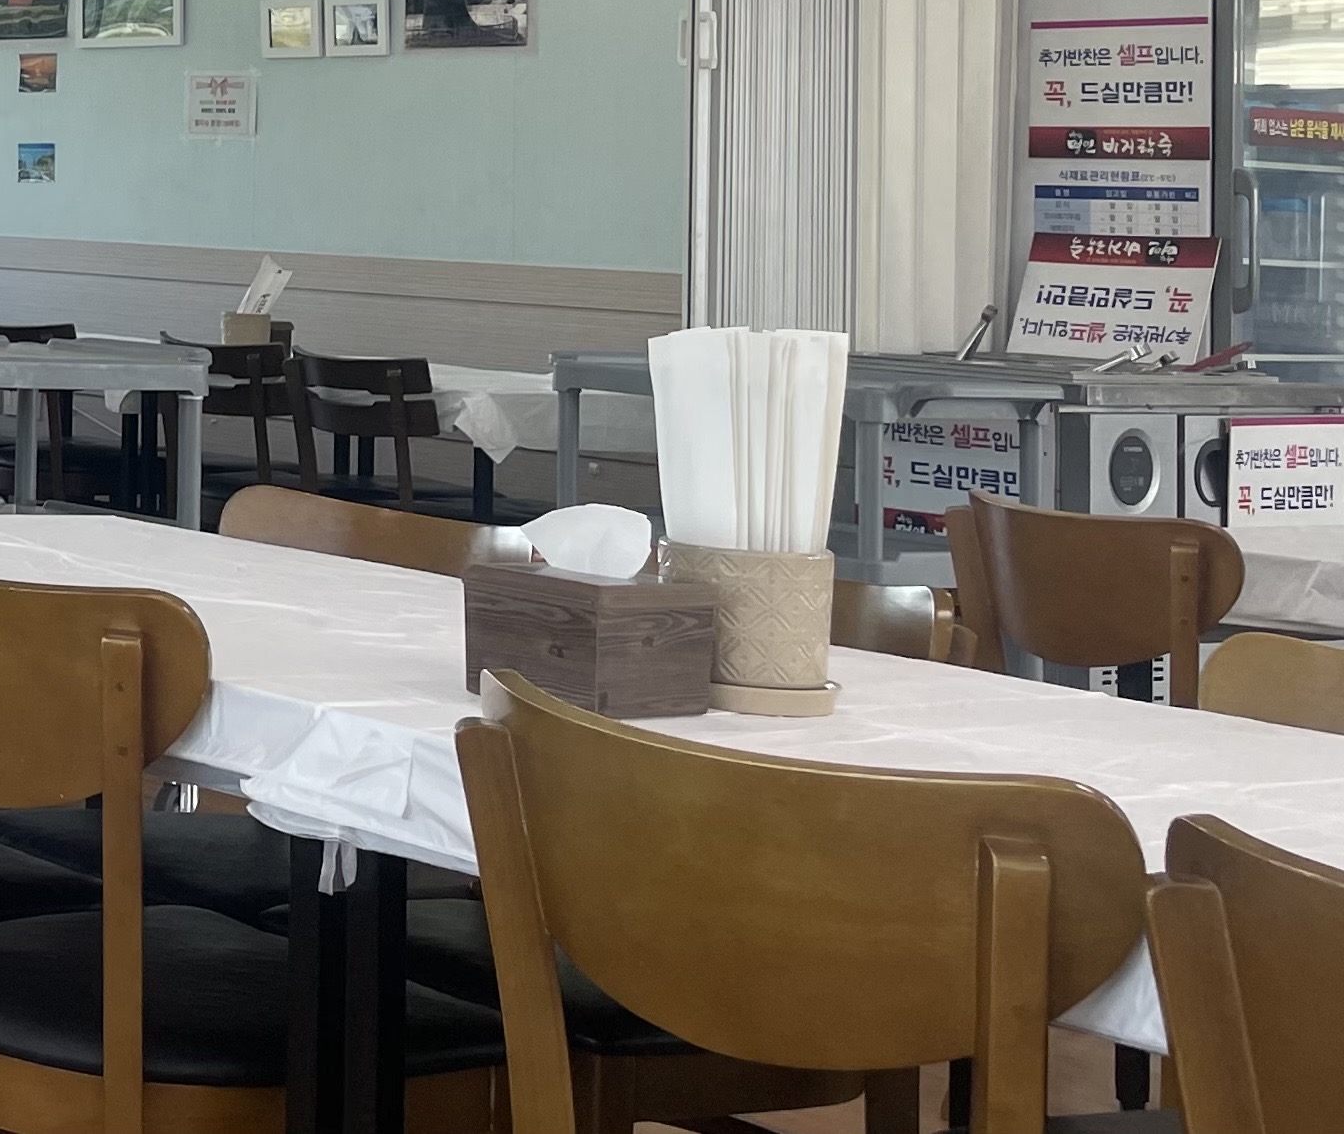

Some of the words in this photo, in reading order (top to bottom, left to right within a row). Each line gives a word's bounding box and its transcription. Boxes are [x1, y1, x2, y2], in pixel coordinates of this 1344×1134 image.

[1039, 47, 1112, 67] 추가반찬은
[1117, 44, 1204, 66] 셀프입니다.
[1044, 80, 1071, 108] 꼭,
[1080, 80, 1193, 103] 드실만큼만!
[1102, 132, 1173, 157] 바지락죽
[1036, 284, 1155, 310] 드실만큼만!
[1165, 286, 1193, 313] 꼭,
[1019, 317, 1107, 343] 셀프입니다.
[1113, 324, 1192, 344] 추가반찬은
[883, 423, 945, 446] 가반찬은
[950, 423, 1020, 452] 셀프입니
[1235, 450, 1281, 470] 추가반찬은
[1285, 445, 1342, 468] 셀프입니다.
[1238, 486, 1255, 515] 꼭,
[1261, 485, 1333, 510] 드실만큼만!
